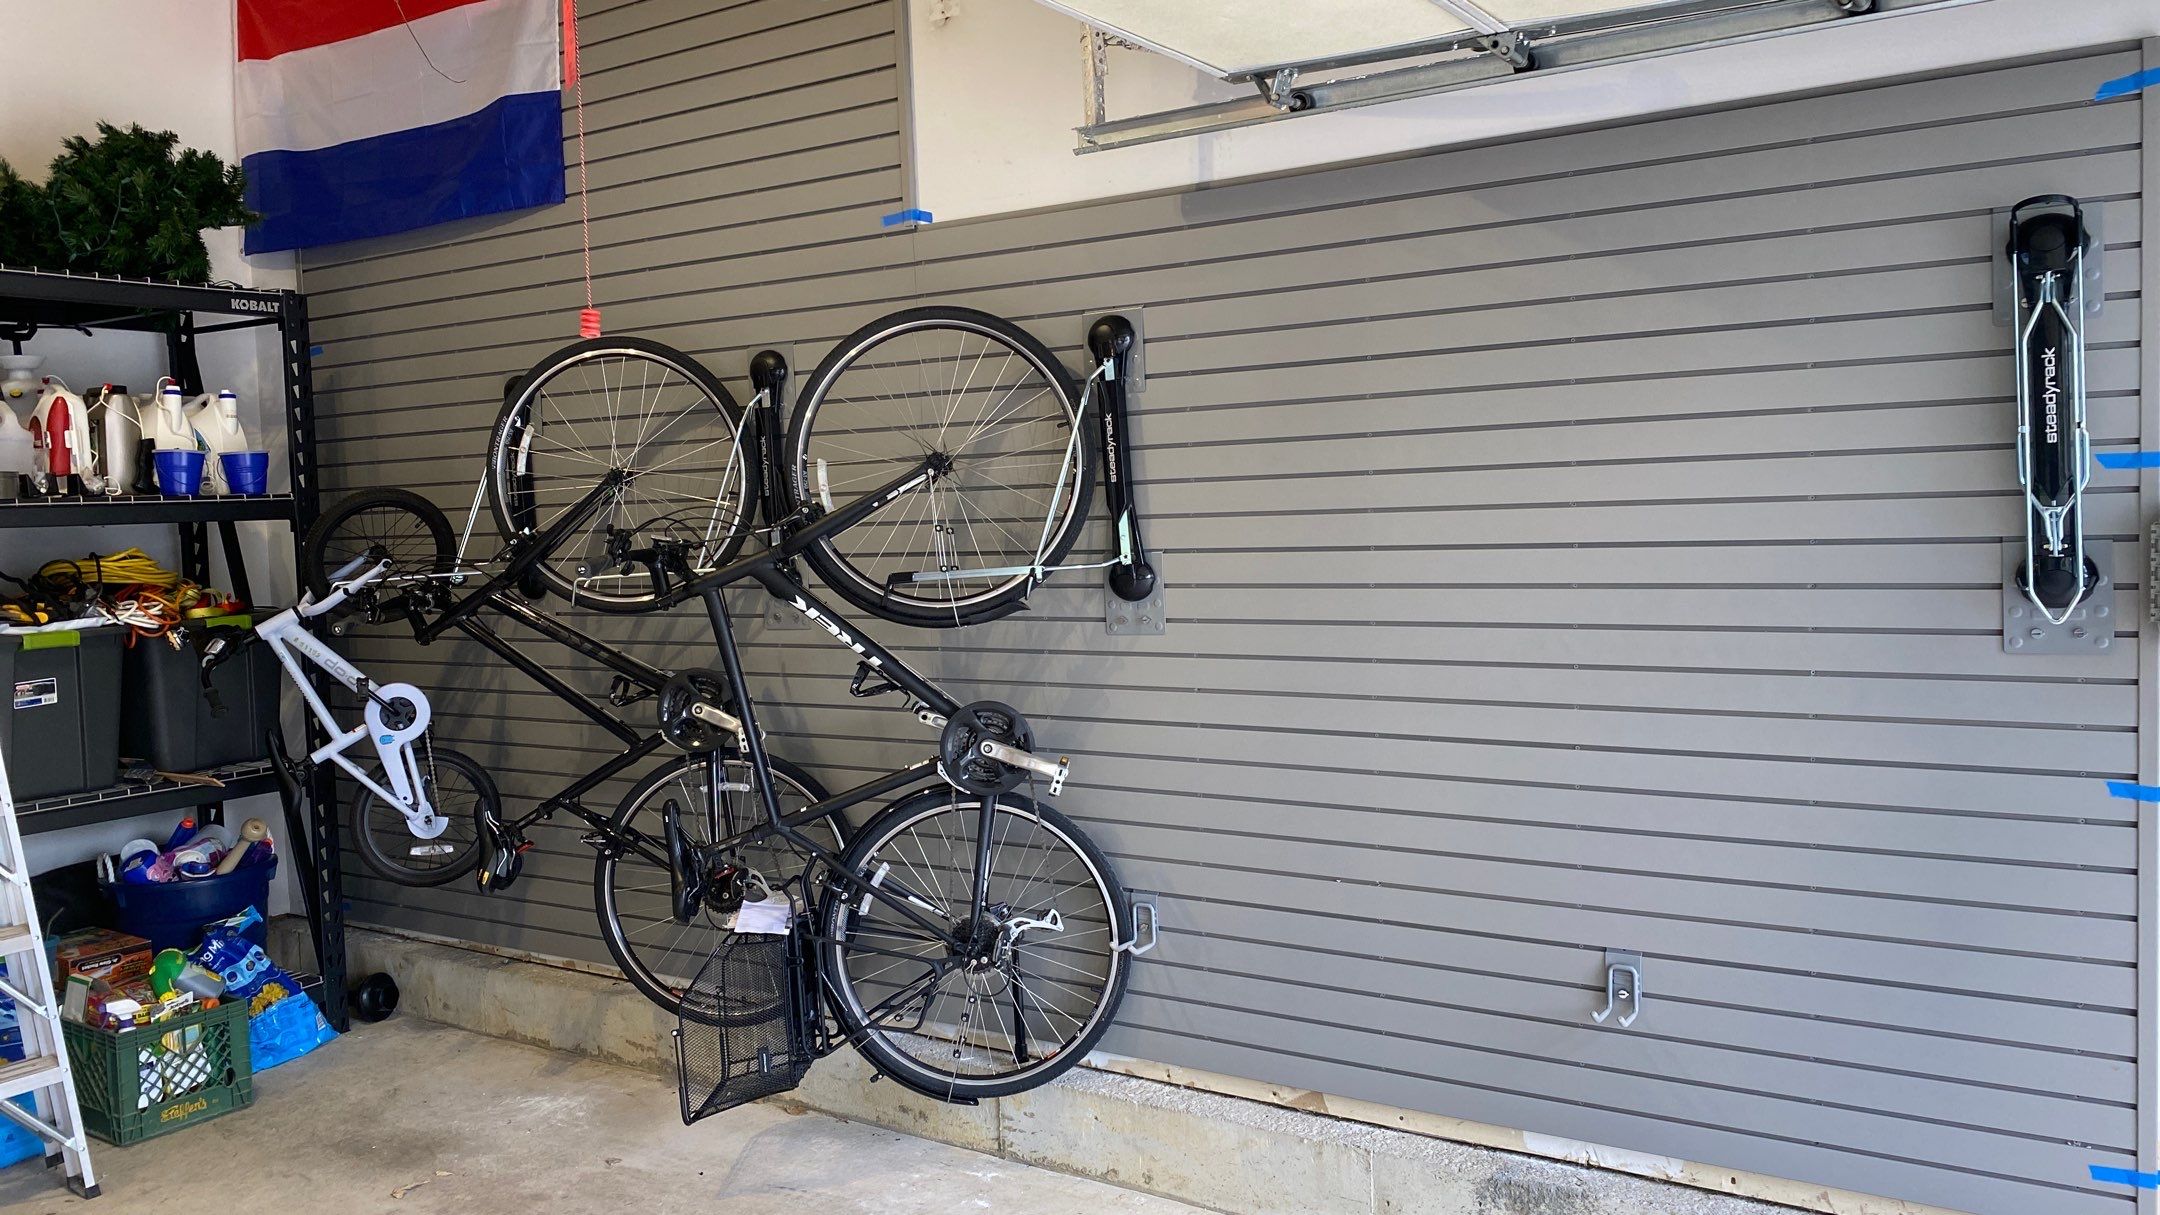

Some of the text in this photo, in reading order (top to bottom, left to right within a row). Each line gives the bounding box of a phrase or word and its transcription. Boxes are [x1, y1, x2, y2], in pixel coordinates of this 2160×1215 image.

[231, 298, 279, 312] KOBALT
[2041, 347, 2060, 444] steadyrack
[492, 415, 508, 464] BONTRAGER
[760, 435, 770, 496] steadyrack
[1104, 412, 1117, 483] steadyrack
[788, 594, 884, 667] TREK
